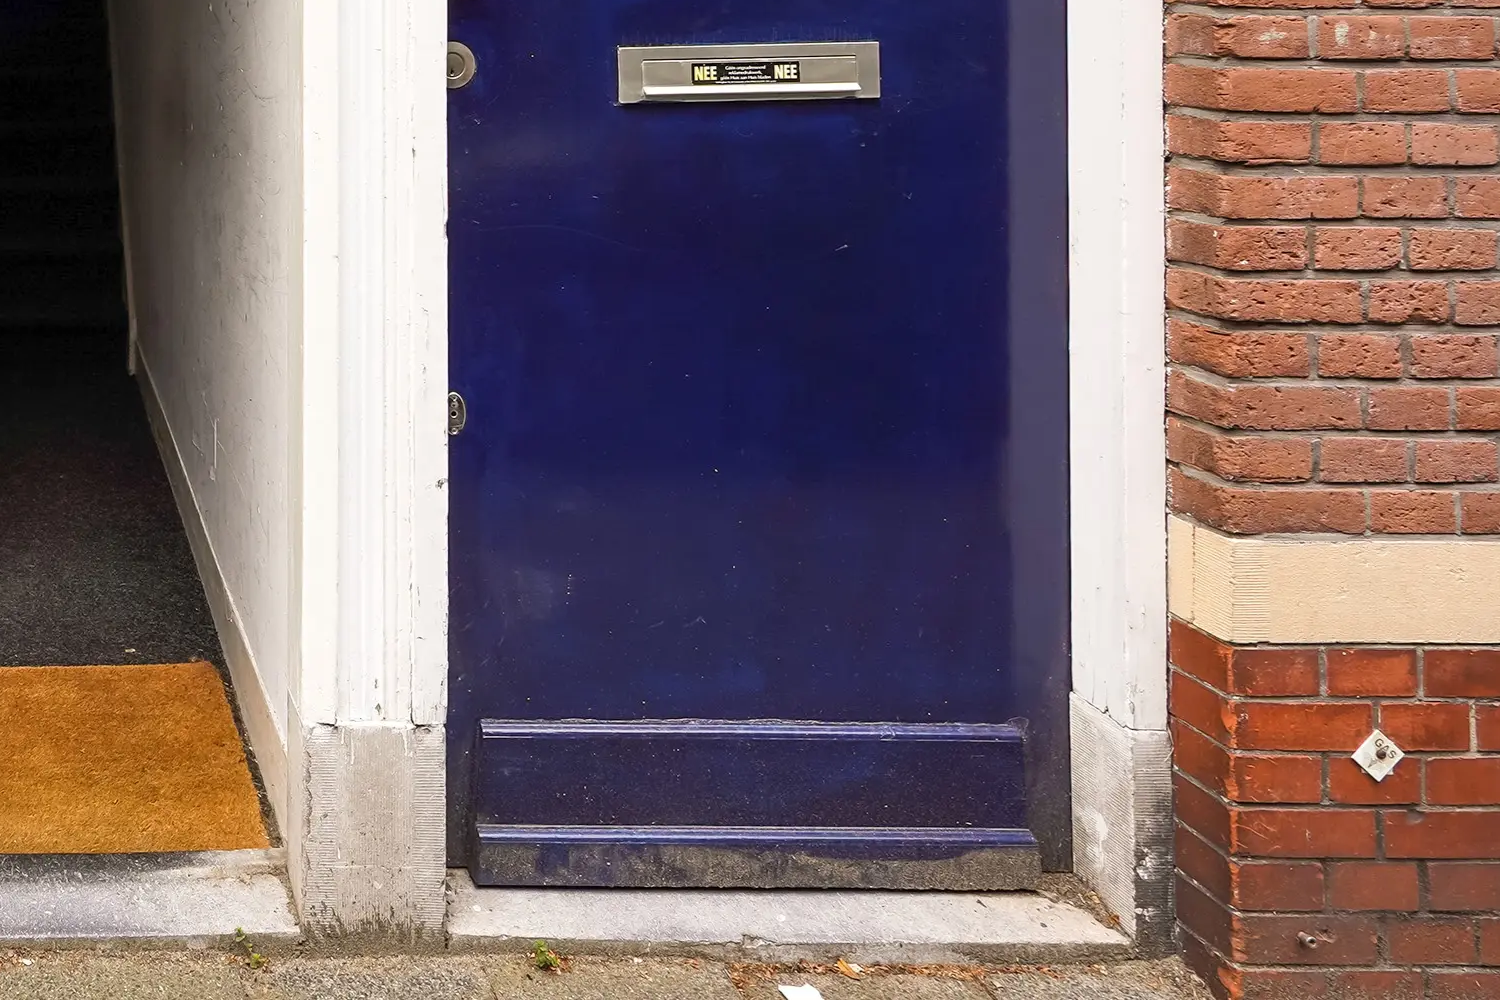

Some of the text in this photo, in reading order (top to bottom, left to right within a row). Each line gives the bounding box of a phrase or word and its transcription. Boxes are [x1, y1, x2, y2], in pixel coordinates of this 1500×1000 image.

[693, 65, 718, 81] NEE
[773, 64, 798, 80] NEE
[1374, 738, 1397, 759] GAS
